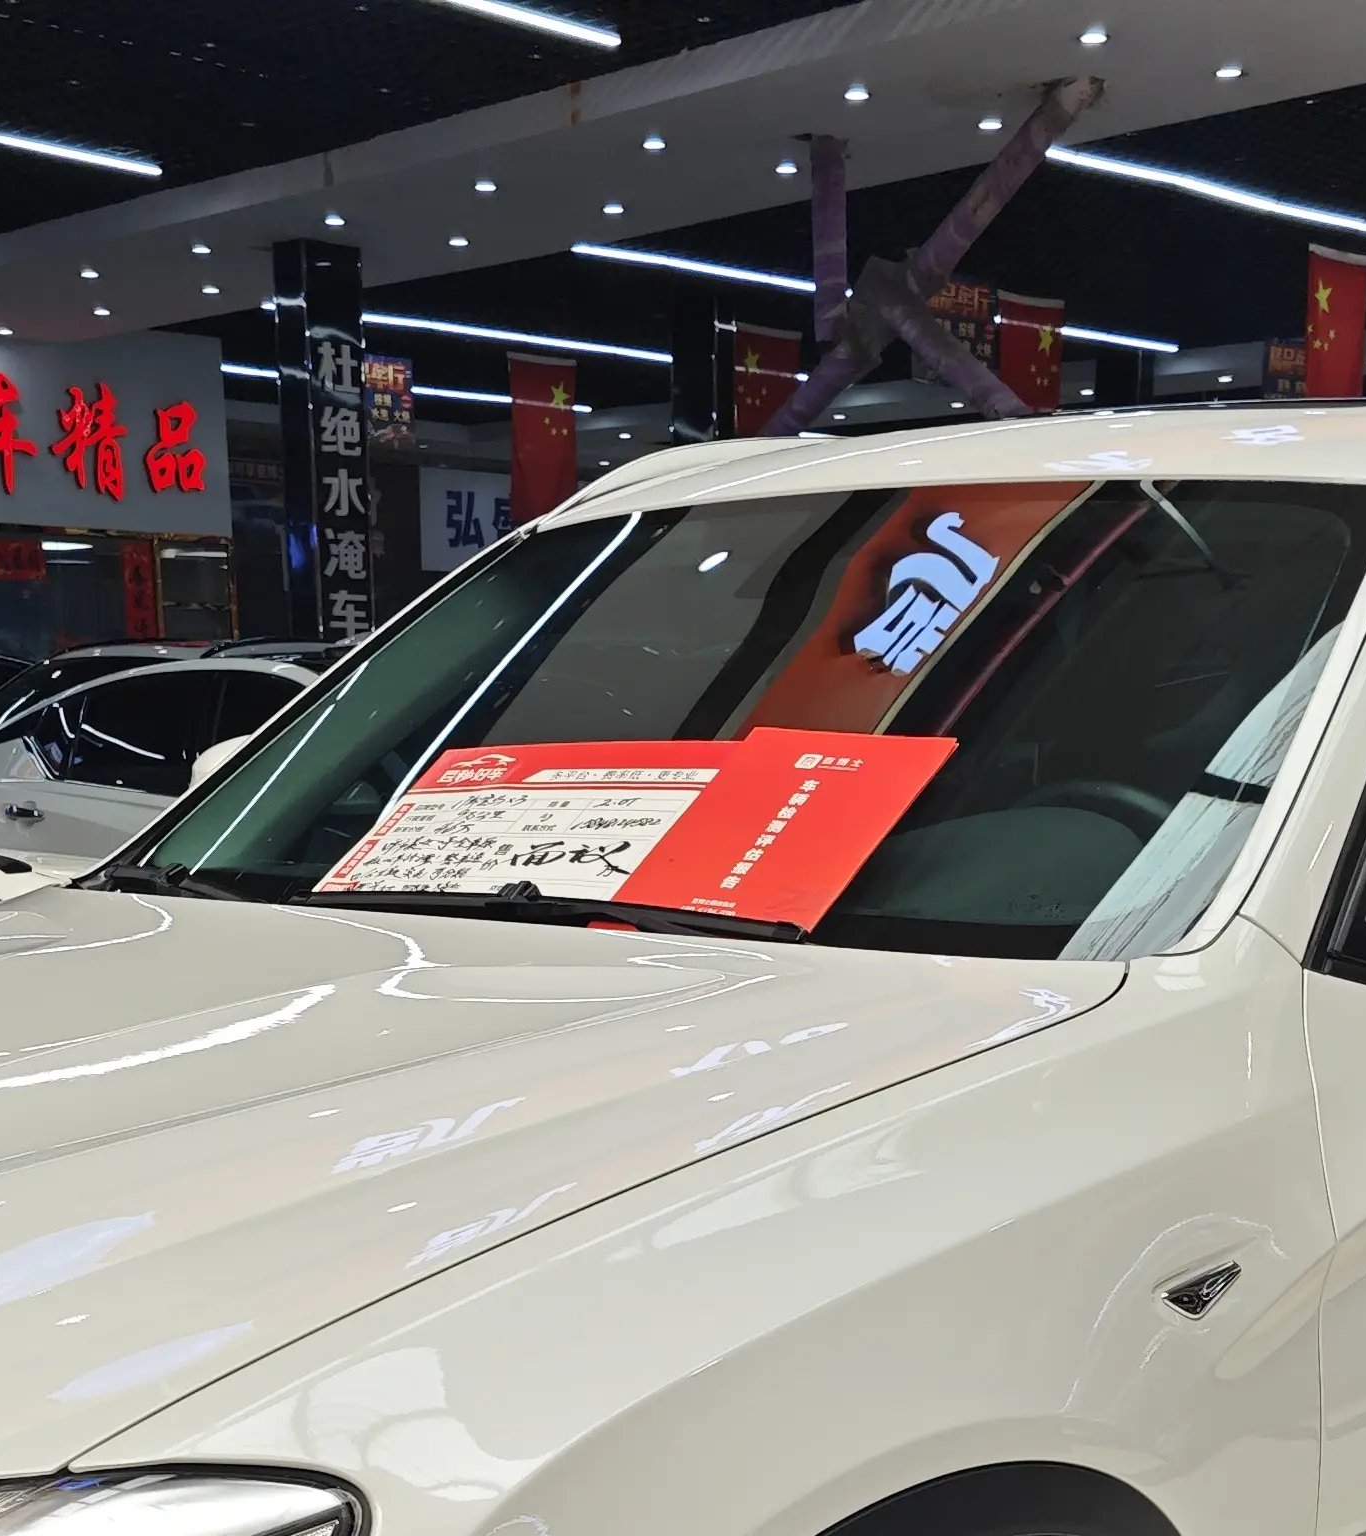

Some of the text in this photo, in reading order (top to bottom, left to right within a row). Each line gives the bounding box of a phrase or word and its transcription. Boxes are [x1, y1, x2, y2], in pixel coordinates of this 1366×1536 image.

[317, 338, 371, 640] 杜绝水淹车
